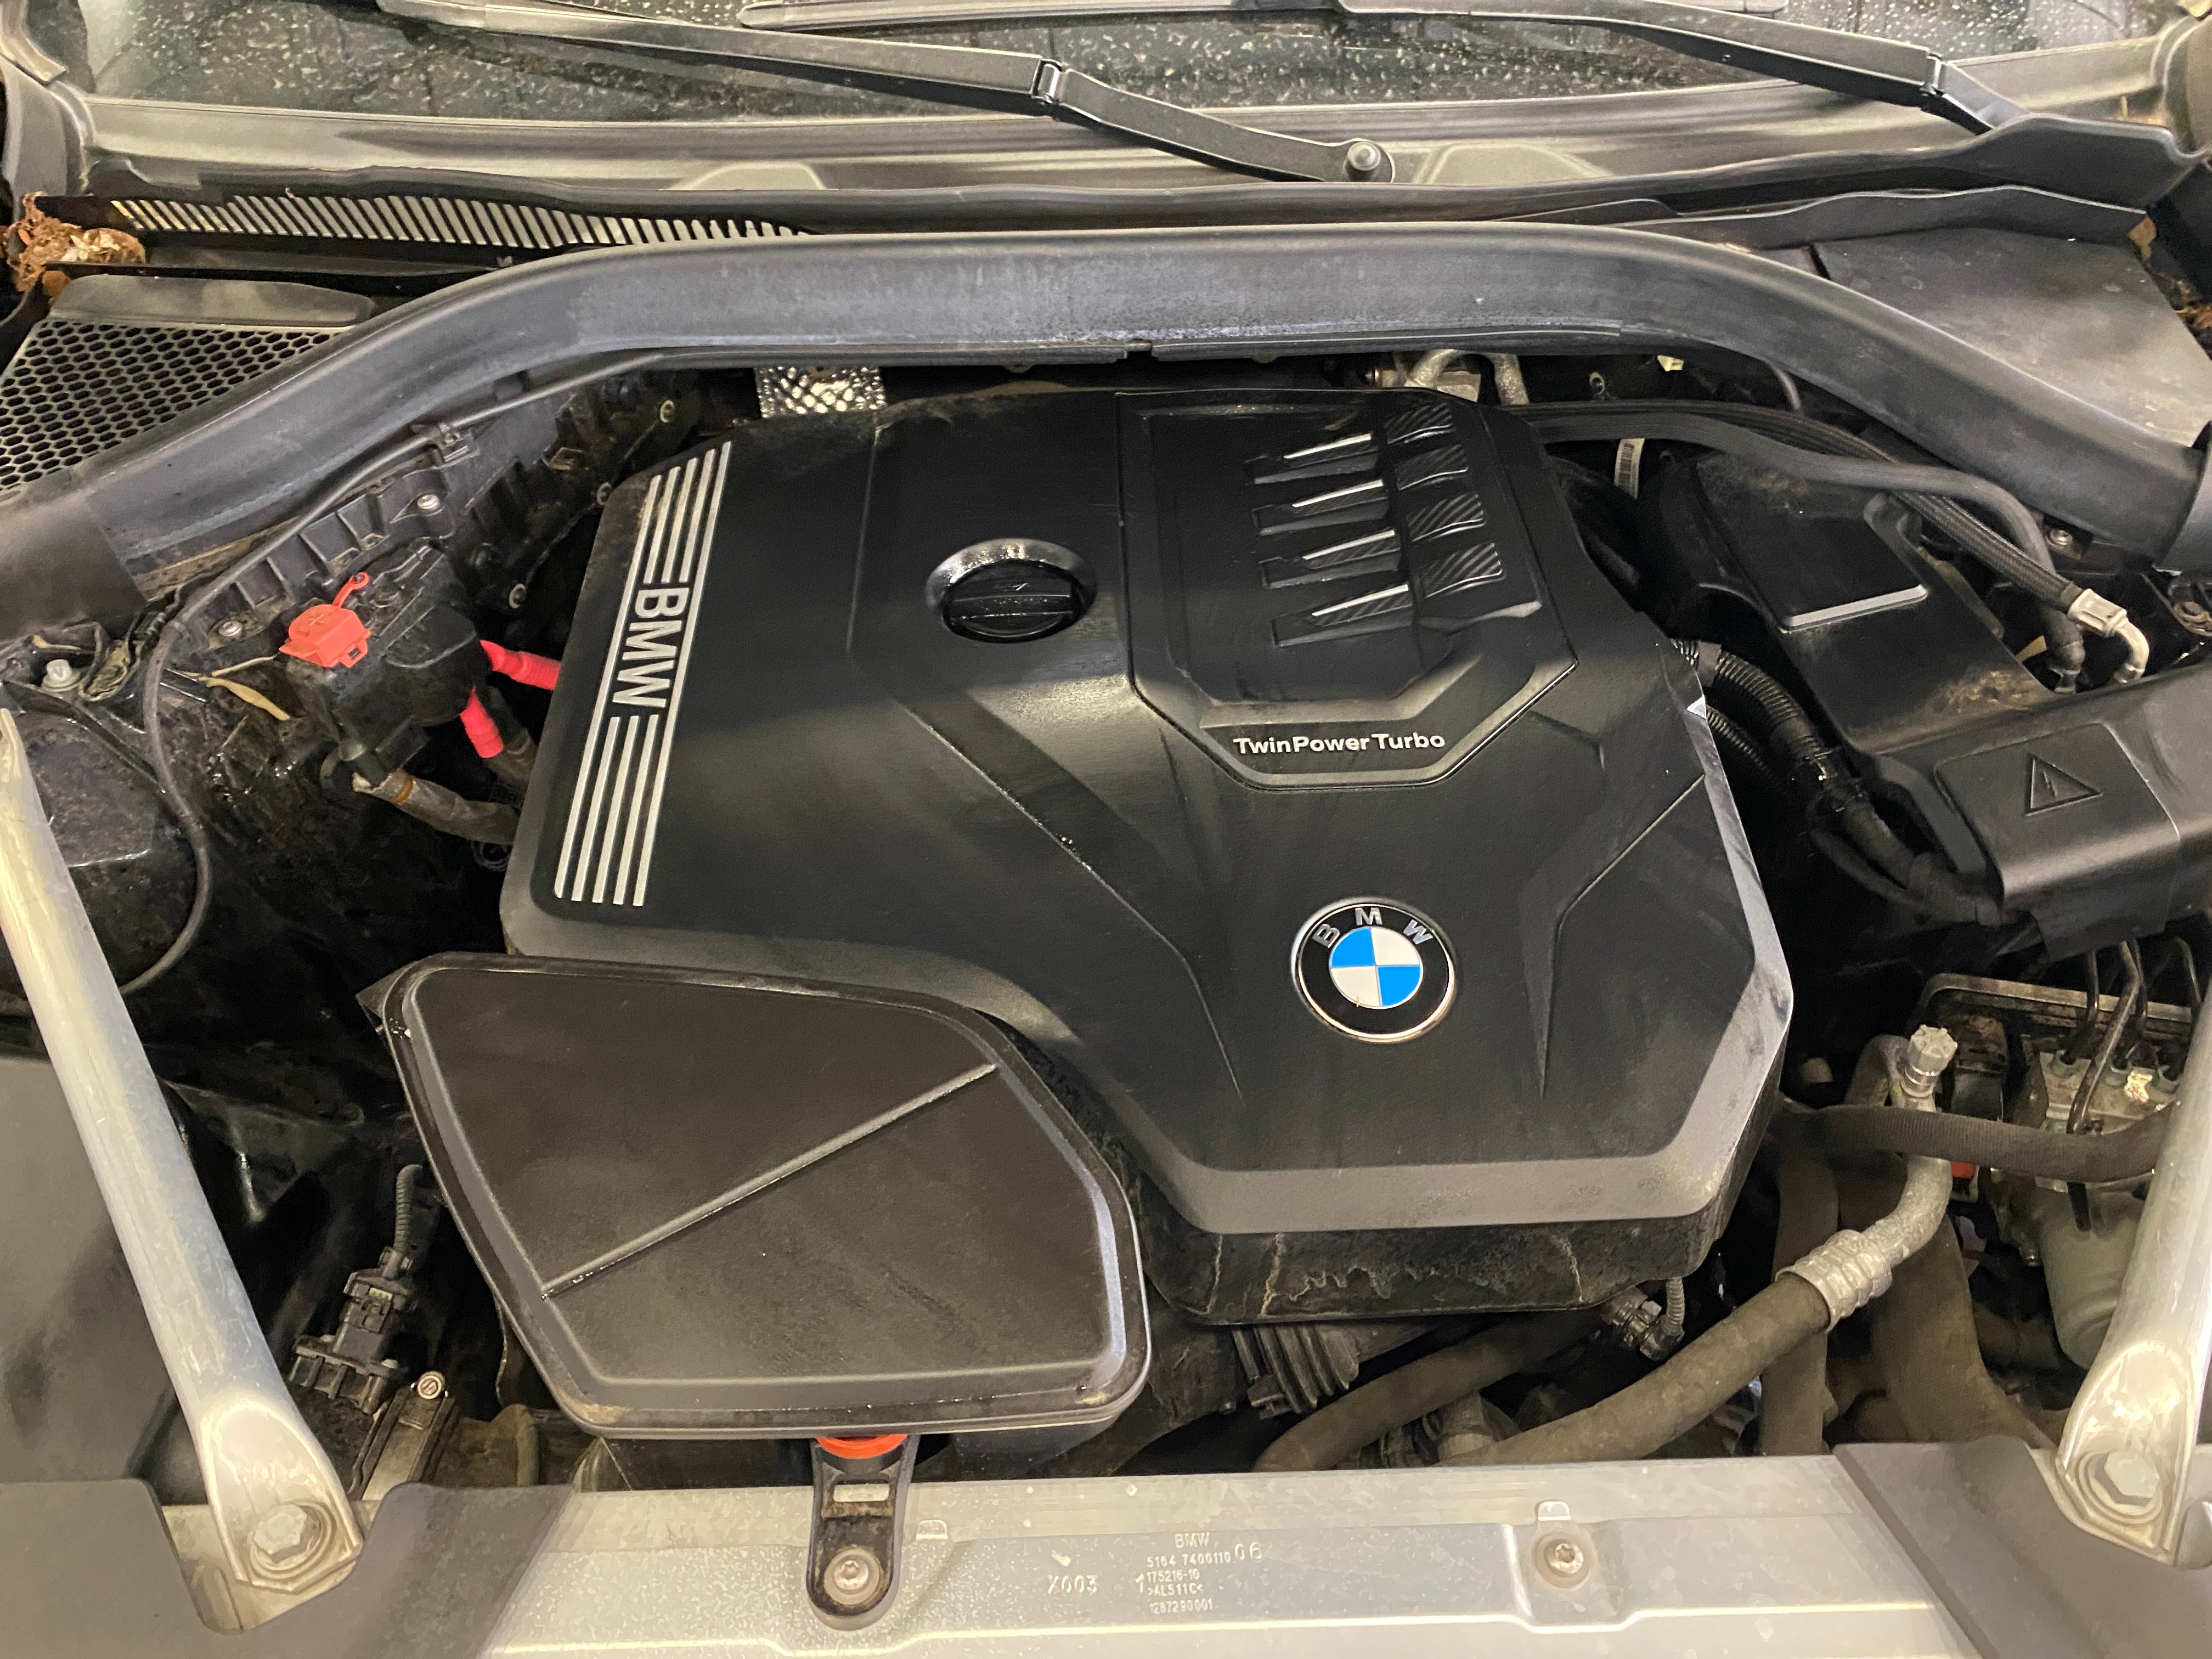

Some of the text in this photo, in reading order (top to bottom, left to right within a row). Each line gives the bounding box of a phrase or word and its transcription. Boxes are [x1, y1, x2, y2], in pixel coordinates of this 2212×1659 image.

[612, 587, 690, 708] BMW
[1311, 907, 1434, 949] BMW
[1175, 1532, 1210, 1548] BMW
[1146, 1554, 1177, 1568] 5164
[1181, 1551, 1231, 1566] 7400110
